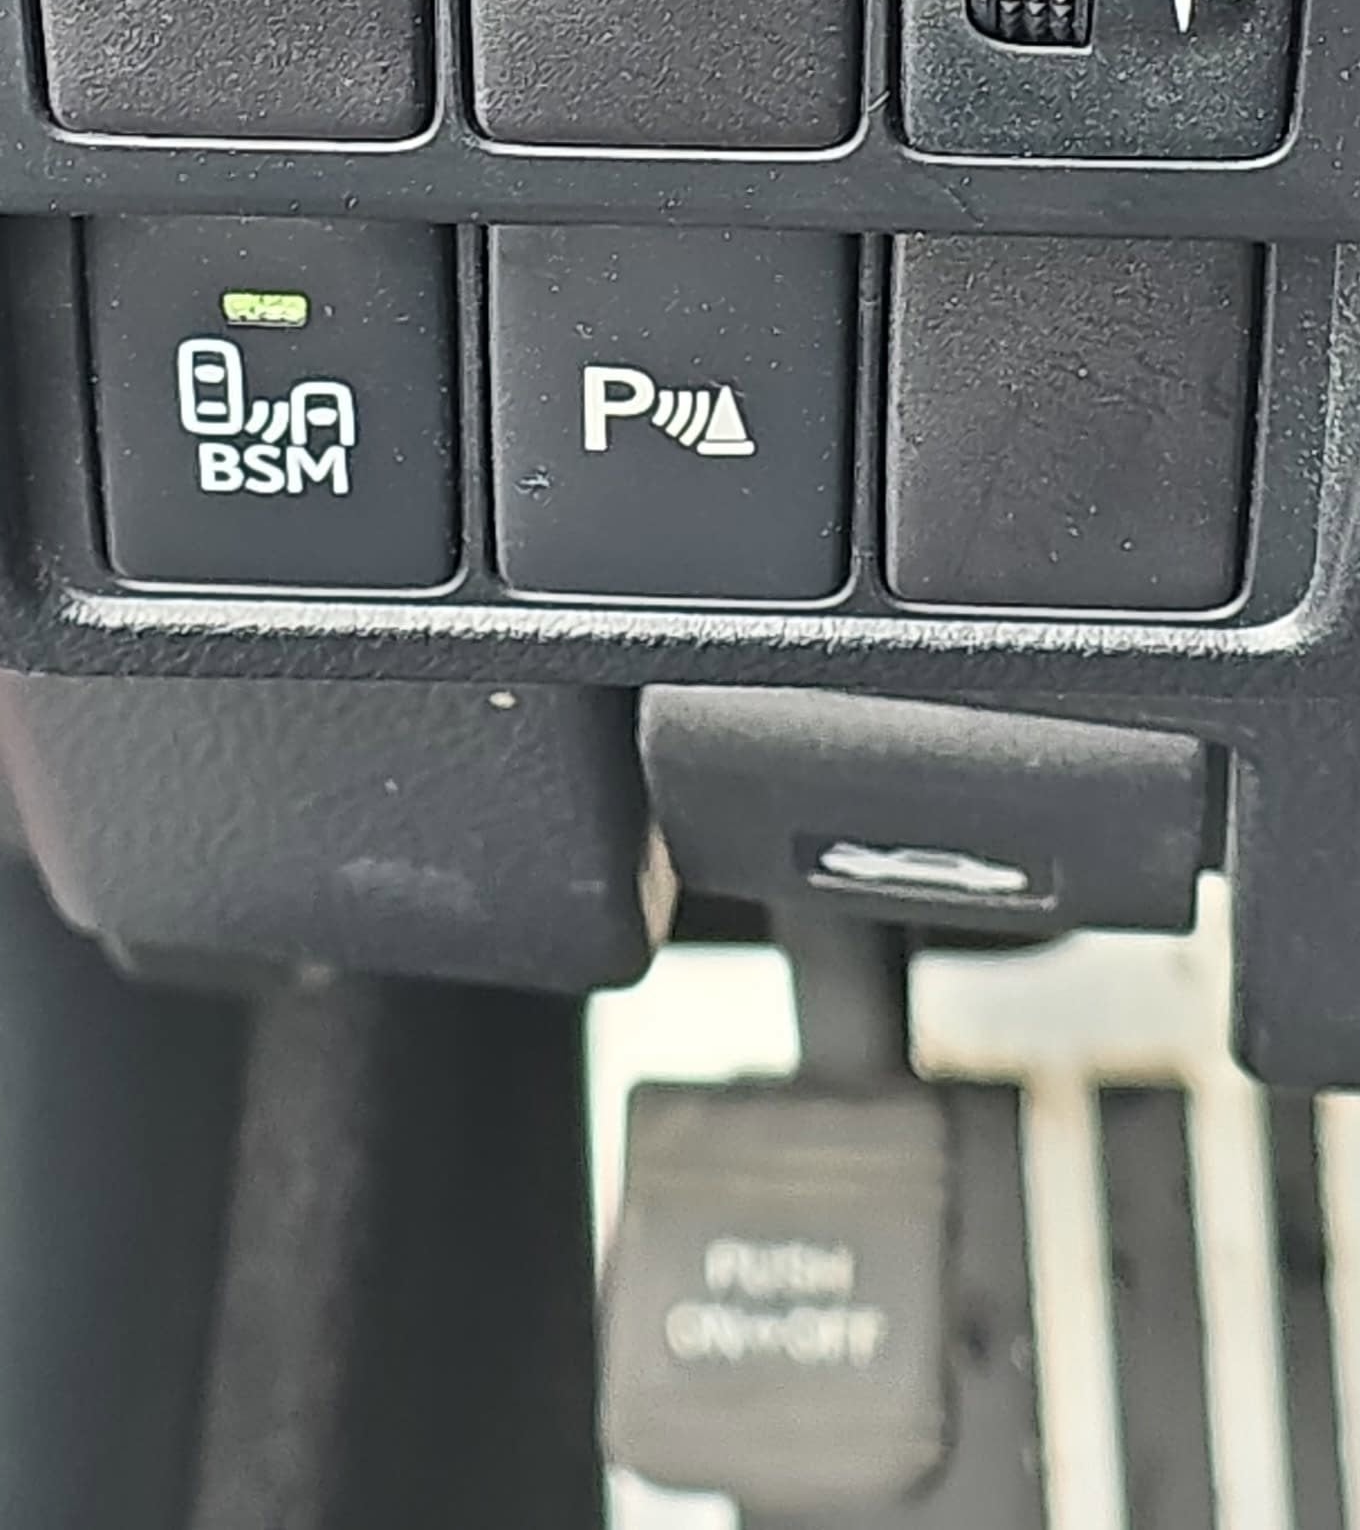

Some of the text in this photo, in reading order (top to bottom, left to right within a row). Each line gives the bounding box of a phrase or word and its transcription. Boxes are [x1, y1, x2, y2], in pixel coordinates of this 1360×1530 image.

[584, 365, 656, 452] P
[198, 442, 350, 495] BSM
[705, 1239, 854, 1295] PUSH
